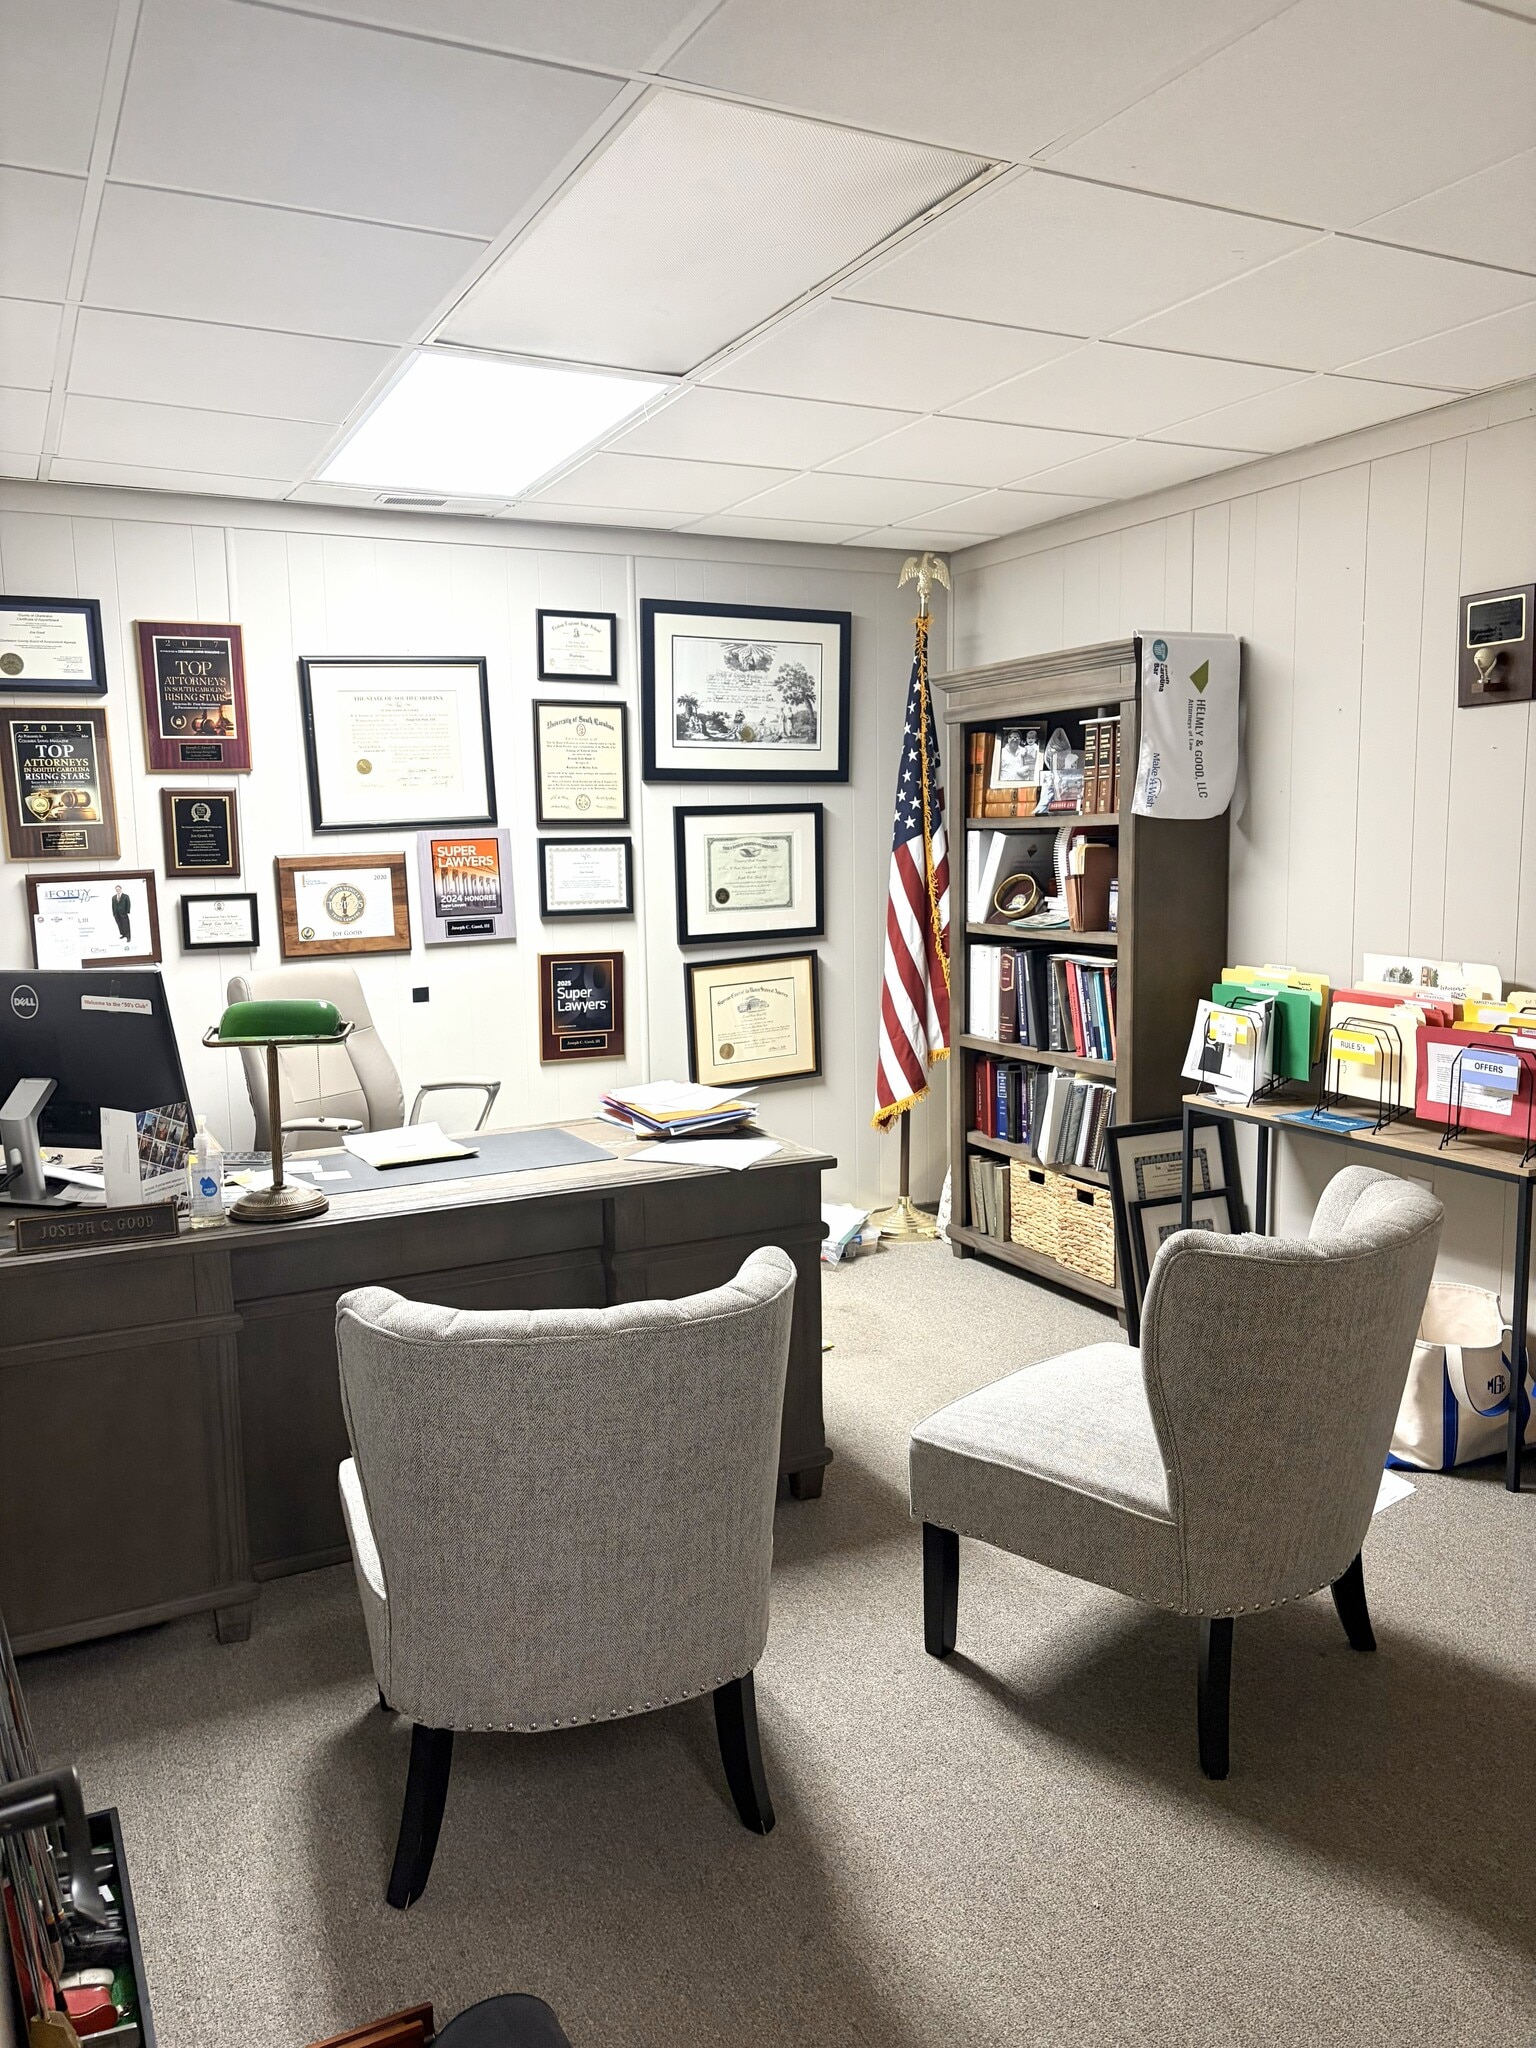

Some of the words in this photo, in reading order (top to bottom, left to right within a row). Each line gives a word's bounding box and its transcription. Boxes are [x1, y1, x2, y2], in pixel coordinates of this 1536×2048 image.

[175, 661, 212, 675] TOP
[164, 676, 226, 686] ATTORNEYS
[199, 694, 227, 702] STARS
[1194, 699, 1206, 737] HELMLY
[35, 744, 74, 758] TOP
[24, 758, 89, 767] ATTORNEYS
[1194, 750, 1204, 780] GOOD,
[1196, 782, 1208, 798] LLC
[437, 846, 476, 856] SUPER
[438, 856, 494, 868] LAWYERS
[49, 889, 90, 898] FORTY
[441, 894, 462, 903] 2024
[557, 987, 592, 1001] Super
[14, 998, 36, 1007] DELL
[558, 1000, 607, 1013] Lawyers
[1340, 1041, 1355, 1049] RULE
[1474, 1062, 1504, 1074] OFFERS
[40, 1222, 95, 1239] JOSEPH
[102, 1220, 113, 1232] C.
[117, 1216, 153, 1230] GOOD
